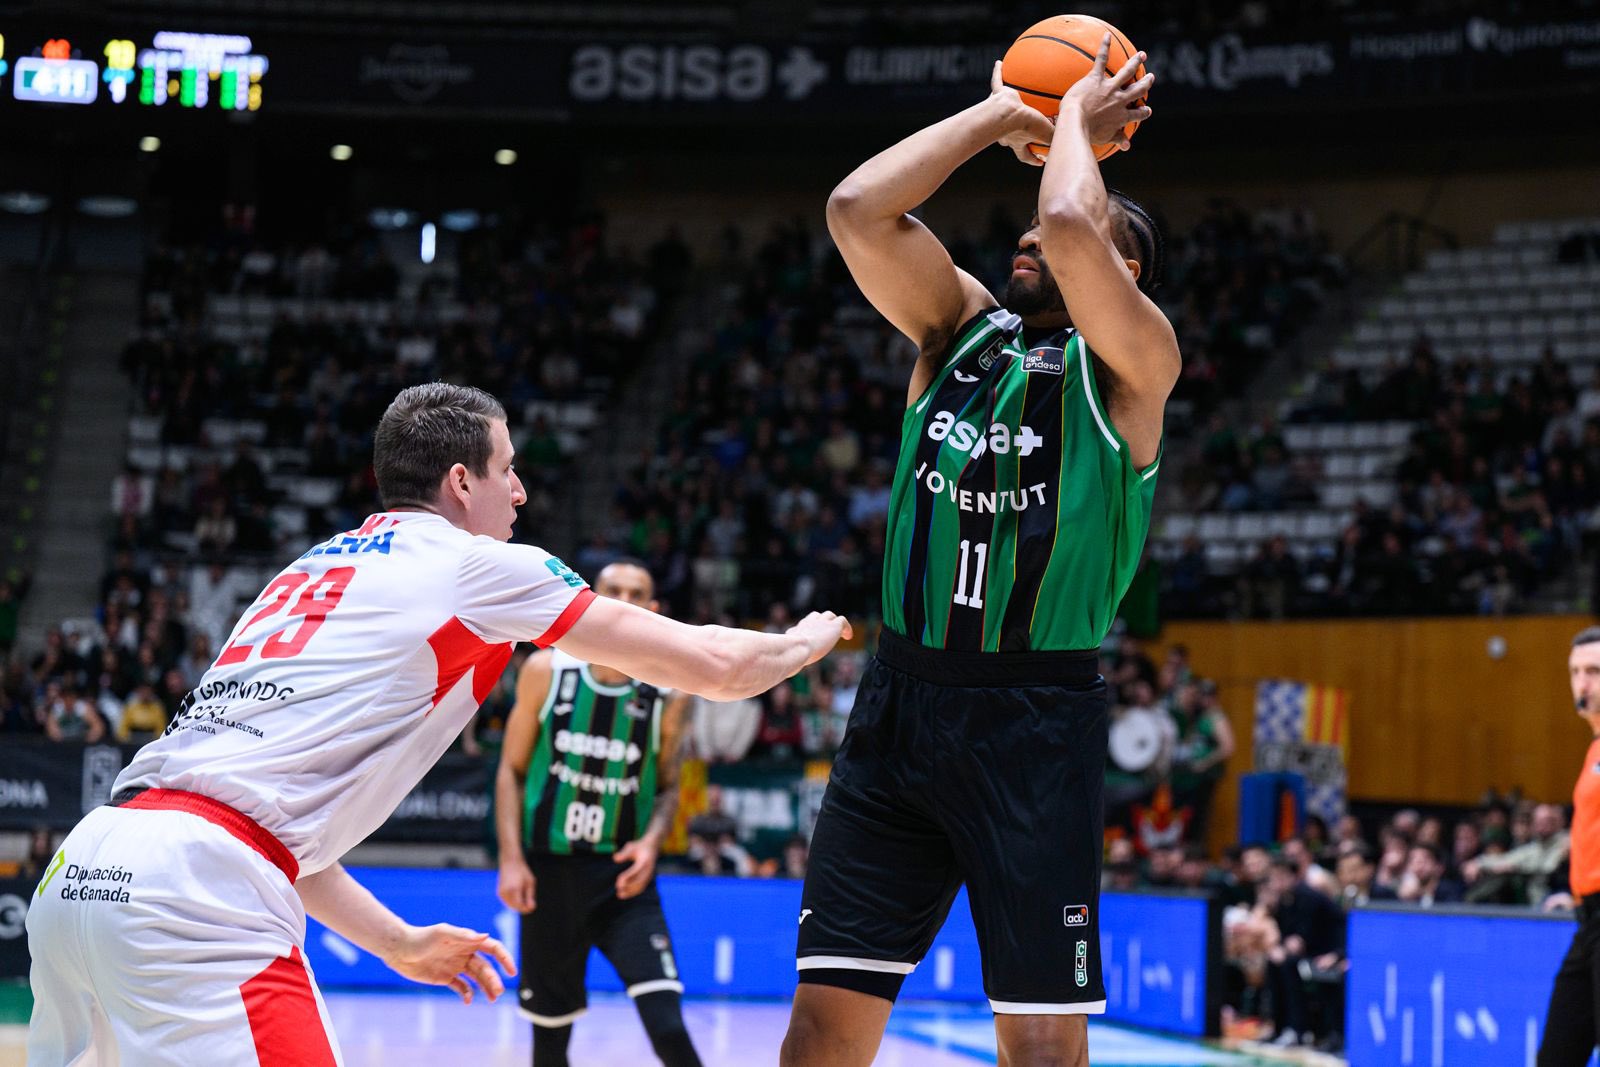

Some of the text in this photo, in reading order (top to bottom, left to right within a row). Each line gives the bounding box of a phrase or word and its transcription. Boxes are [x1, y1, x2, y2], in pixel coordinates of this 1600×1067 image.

[570, 45, 771, 101] asisa
[1026, 361, 1060, 370] endesa
[928, 410, 1010, 460] asia
[953, 539, 987, 609] 11
[215, 566, 356, 668] 29
[235, 722, 264, 739] CULTURA
[564, 801, 606, 843] 88
[61, 883, 130, 904] de Ganada
[1067, 913, 1084, 924] acb
